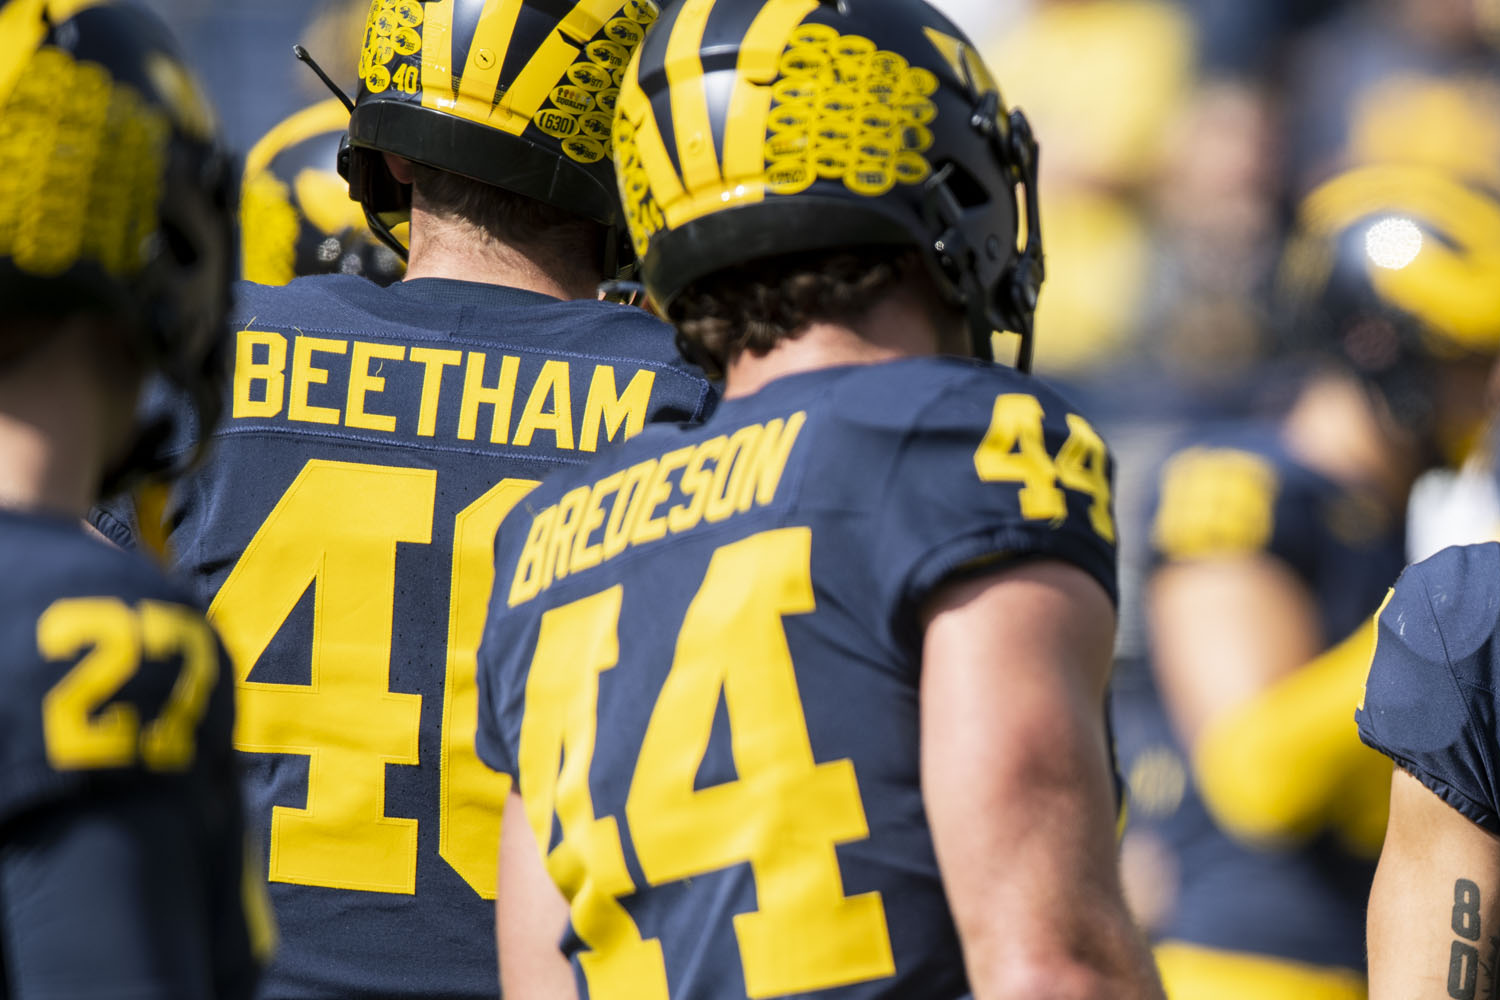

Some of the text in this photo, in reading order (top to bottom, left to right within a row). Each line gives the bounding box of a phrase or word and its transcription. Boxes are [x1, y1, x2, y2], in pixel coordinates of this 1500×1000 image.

[392, 63, 419, 94] 40
[539, 113, 576, 135] (630)
[233, 330, 656, 453] BEETHAM
[508, 410, 807, 608] BREDESON
[973, 392, 1115, 544] 44
[36, 596, 220, 773] 27
